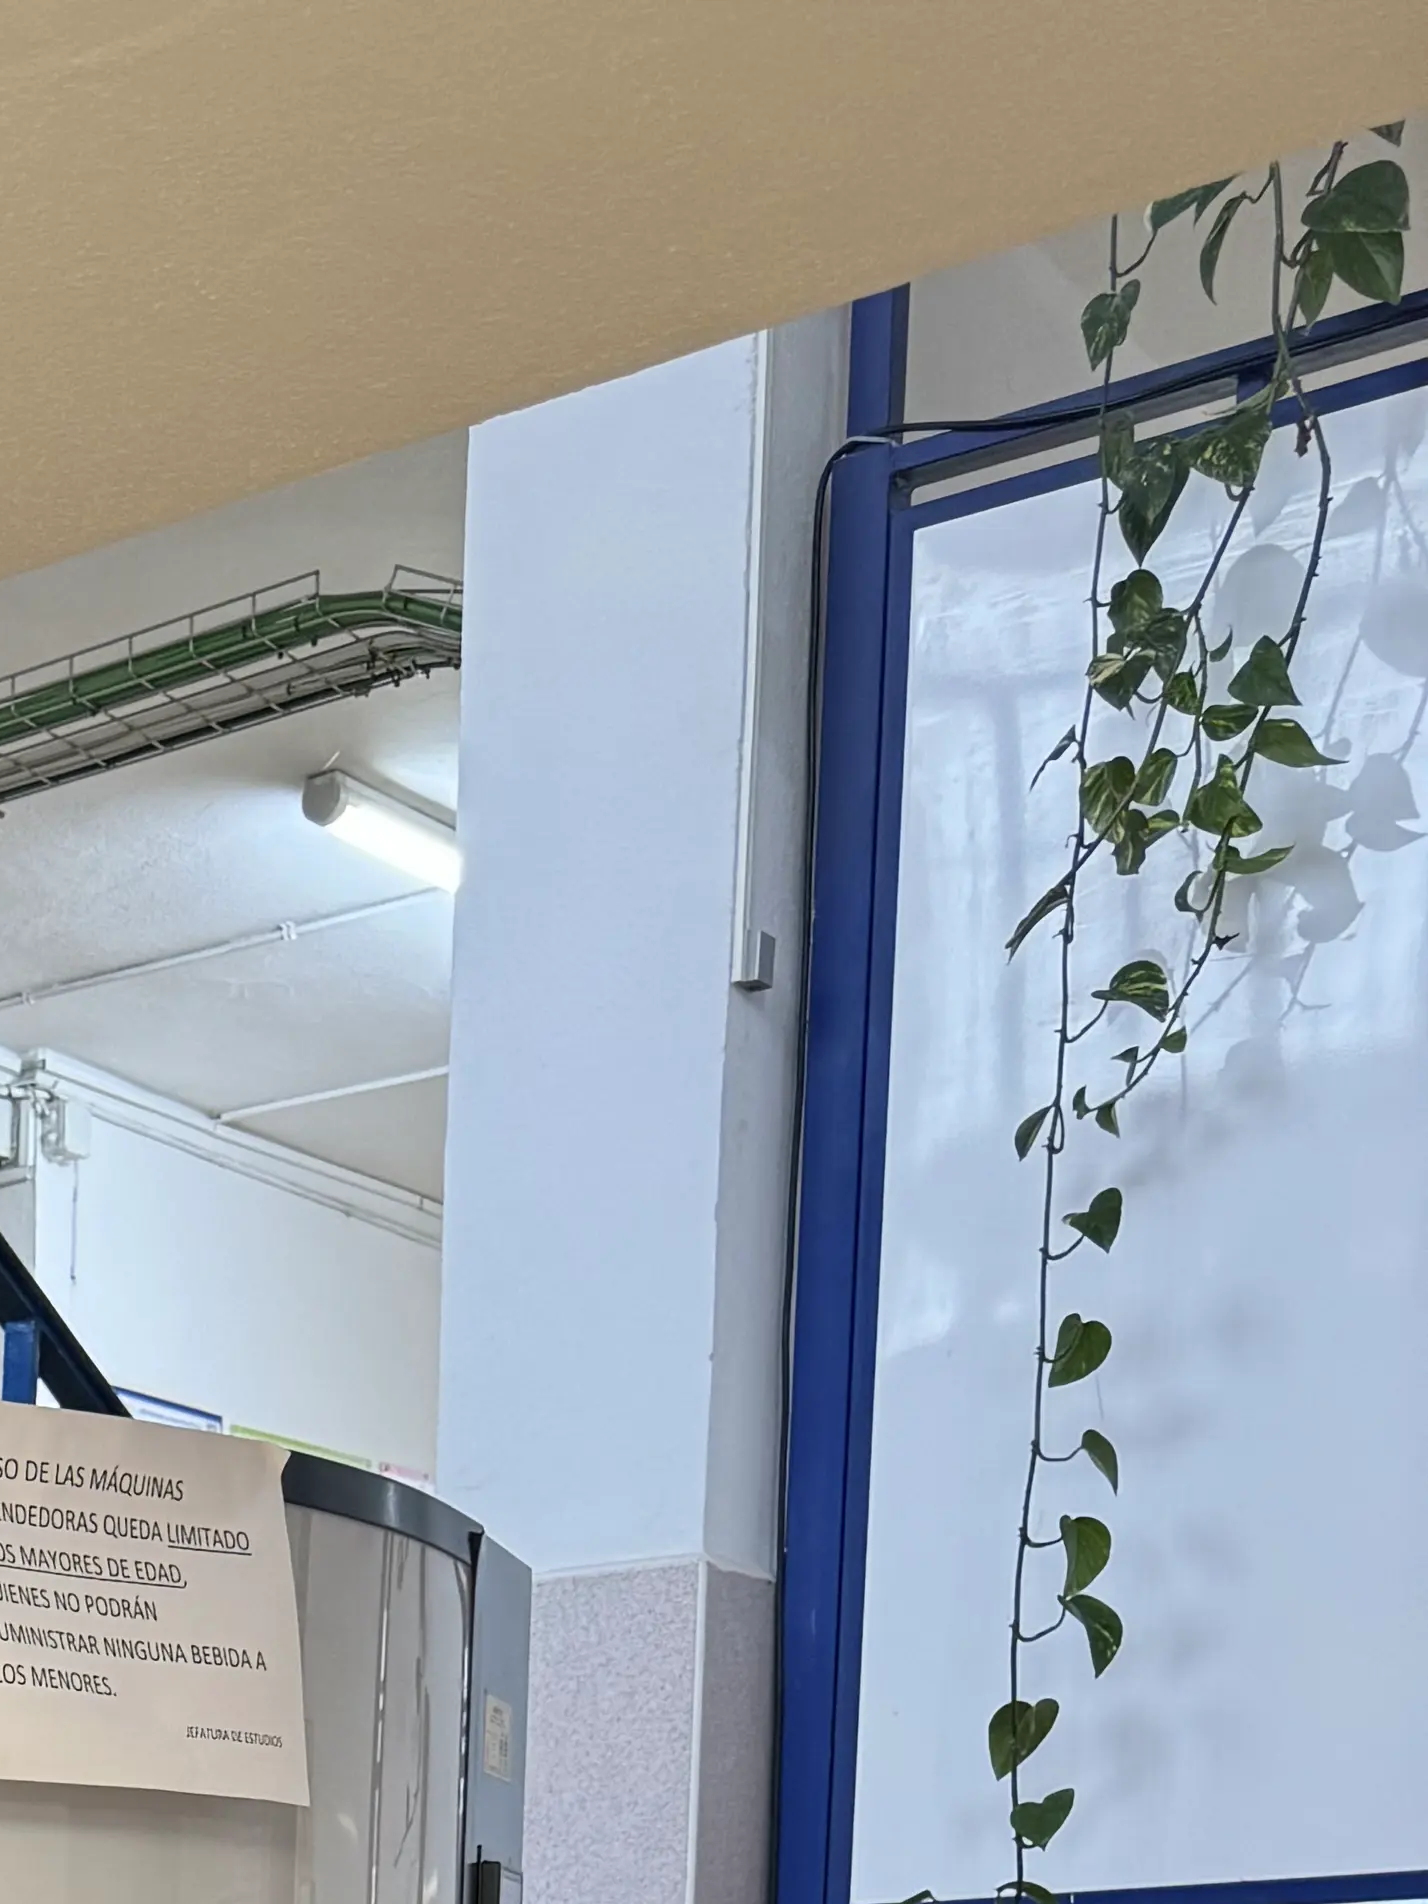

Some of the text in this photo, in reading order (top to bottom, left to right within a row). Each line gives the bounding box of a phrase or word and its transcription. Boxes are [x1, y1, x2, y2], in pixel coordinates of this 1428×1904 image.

[24, 1460, 50, 1483] DE
[54, 1463, 85, 1488] LAS
[89, 1464, 185, 1502] MÁQUINAS
[102, 1514, 163, 1543] QUEDA
[166, 1522, 251, 1551] LIMITADO
[19, 1546, 104, 1577] MAYORES
[106, 1557, 131, 1580] DE
[54, 1590, 81, 1614] NO
[86, 1595, 159, 1622] PODRÁN
[103, 1637, 189, 1664] NINGUNA
[190, 1644, 253, 1670] BEBIDA
[255, 1650, 268, 1672] A
[30, 1665, 118, 1697] MENORES.
[244, 1731, 283, 1749] ESTUDIOS
